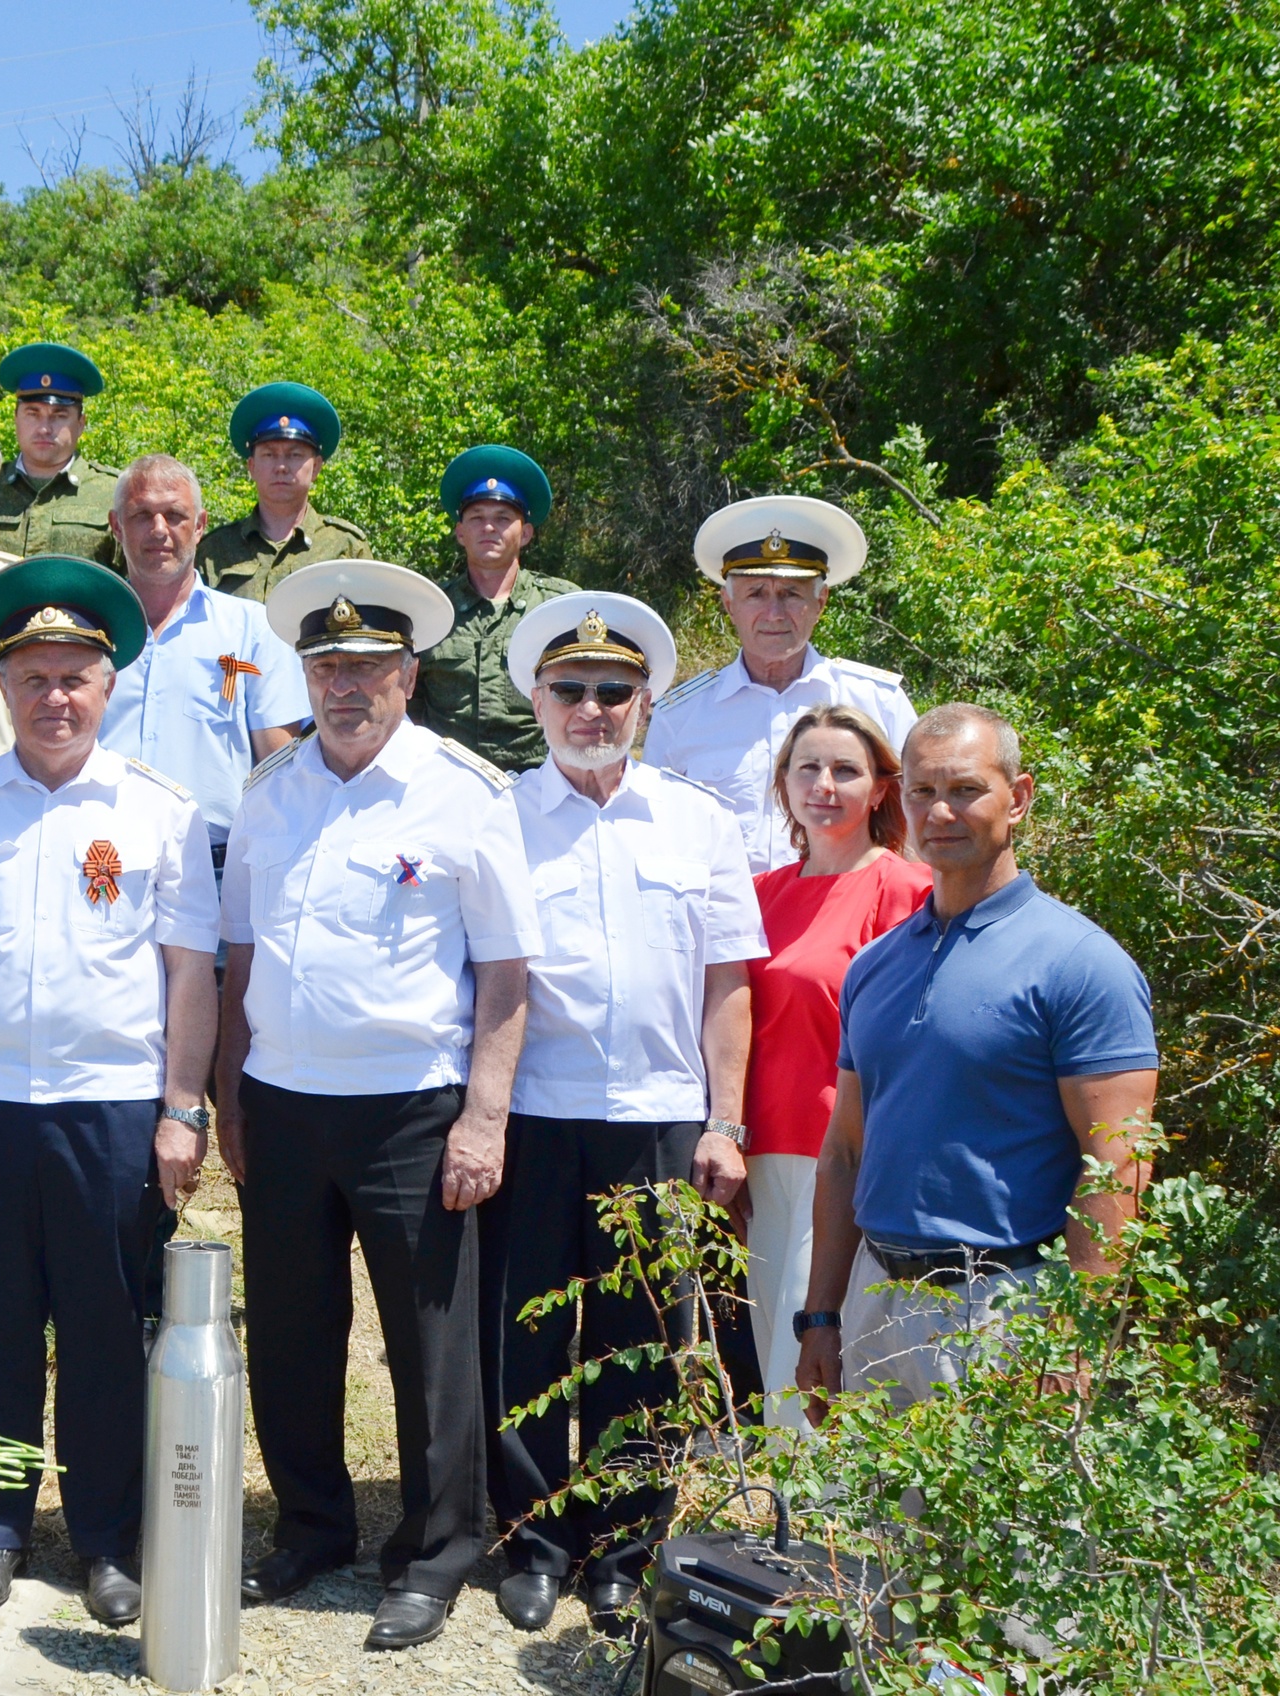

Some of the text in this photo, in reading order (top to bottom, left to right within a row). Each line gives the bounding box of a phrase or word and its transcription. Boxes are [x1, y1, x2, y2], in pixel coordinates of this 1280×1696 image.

[175, 1444, 183, 1452] 09
[176, 1452, 191, 1460] 1945
[178, 1463, 196, 1471] ДЕНЬ
[171, 1471, 203, 1481] ПОБЕДЫ!
[174, 1484, 200, 1492] ВЕЧНАЯ
[173, 1500, 201, 1508] ГЕРОЯМ!
[688, 1588, 731, 1617] SVEN
